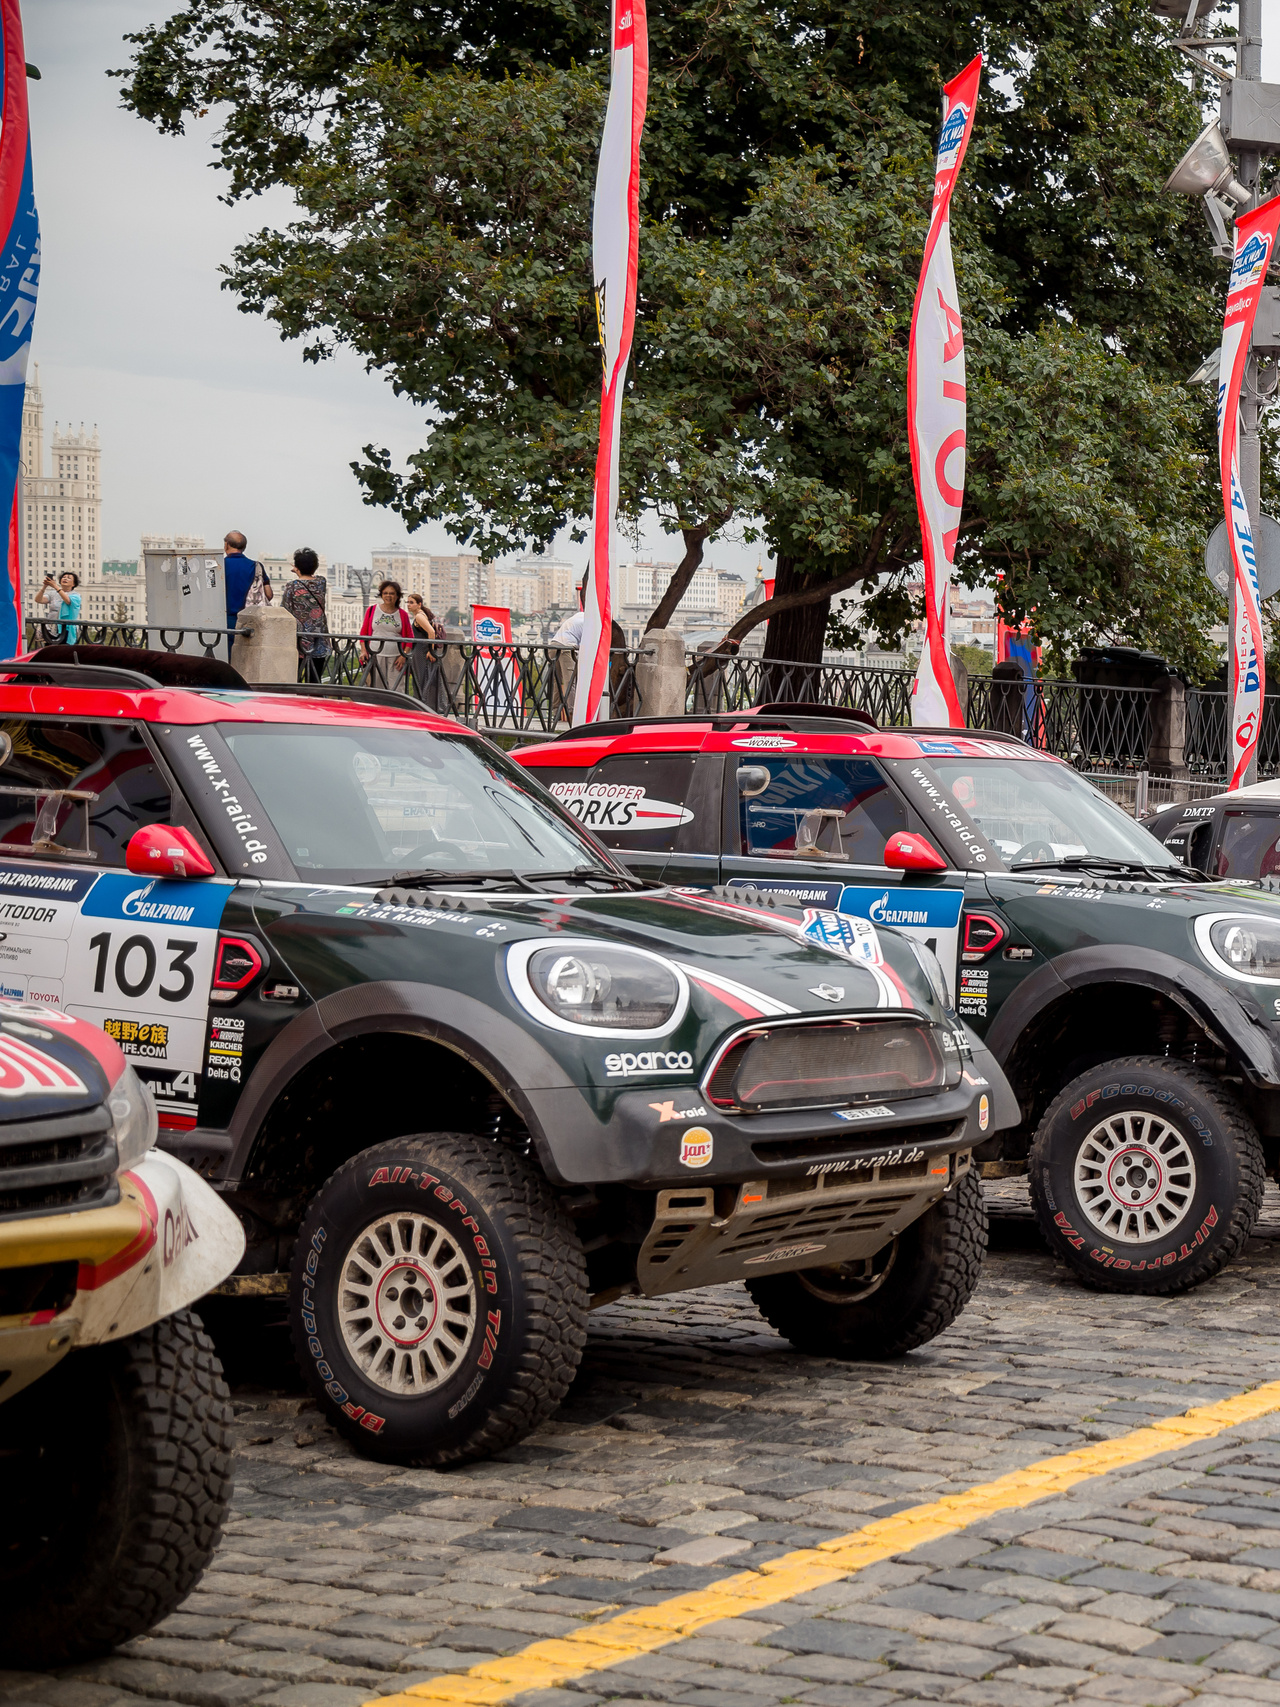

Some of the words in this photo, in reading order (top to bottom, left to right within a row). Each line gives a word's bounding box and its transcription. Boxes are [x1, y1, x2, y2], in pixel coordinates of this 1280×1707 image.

[748, 739, 782, 748] WORKS
[187, 734, 268, 864] www.x-raid.de
[550, 783, 587, 798] JOHN
[587, 785, 644, 801] COOPER
[910, 767, 987, 863] www.x-raid.de
[1182, 807, 1216, 817] DMTP
[1066, 891, 1103, 900] ROMA
[1072, 886, 1106, 896] HARO
[139, 901, 196, 922] GAZPROM
[370, 910, 390, 920] AL
[391, 911, 437, 926] RAJHI
[382, 903, 474, 924] GOTTSCHALK
[885, 910, 928, 924] GAZPROM
[487, 922, 508, 931] A+
[855, 922, 873, 937] 103
[88, 931, 198, 1002] 103
[961, 968, 990, 979] sparco
[3, 987, 24, 998] GAZPROM
[29, 991, 60, 1004] TOYOTA
[959, 997, 988, 1005] RECARO
[959, 1005, 977, 1014] Delta
[212, 1016, 246, 1031] sparco
[208, 1054, 243, 1067] RECARO
[605, 1050, 694, 1077] sparco
[207, 1067, 230, 1080] Delta
[1069, 1083, 1214, 1147] BFGoodrich
[681, 1143, 706, 1162] jan
[806, 1147, 925, 1177] www.x-raid.de
[1053, 1211, 1086, 1250] T/A
[1089, 1204, 1220, 1271] All-Terrain
[368, 1166, 499, 1295] All-Terrain
[477, 1309, 501, 1370] T/A
[301, 1226, 387, 1434] BFGoodrich
